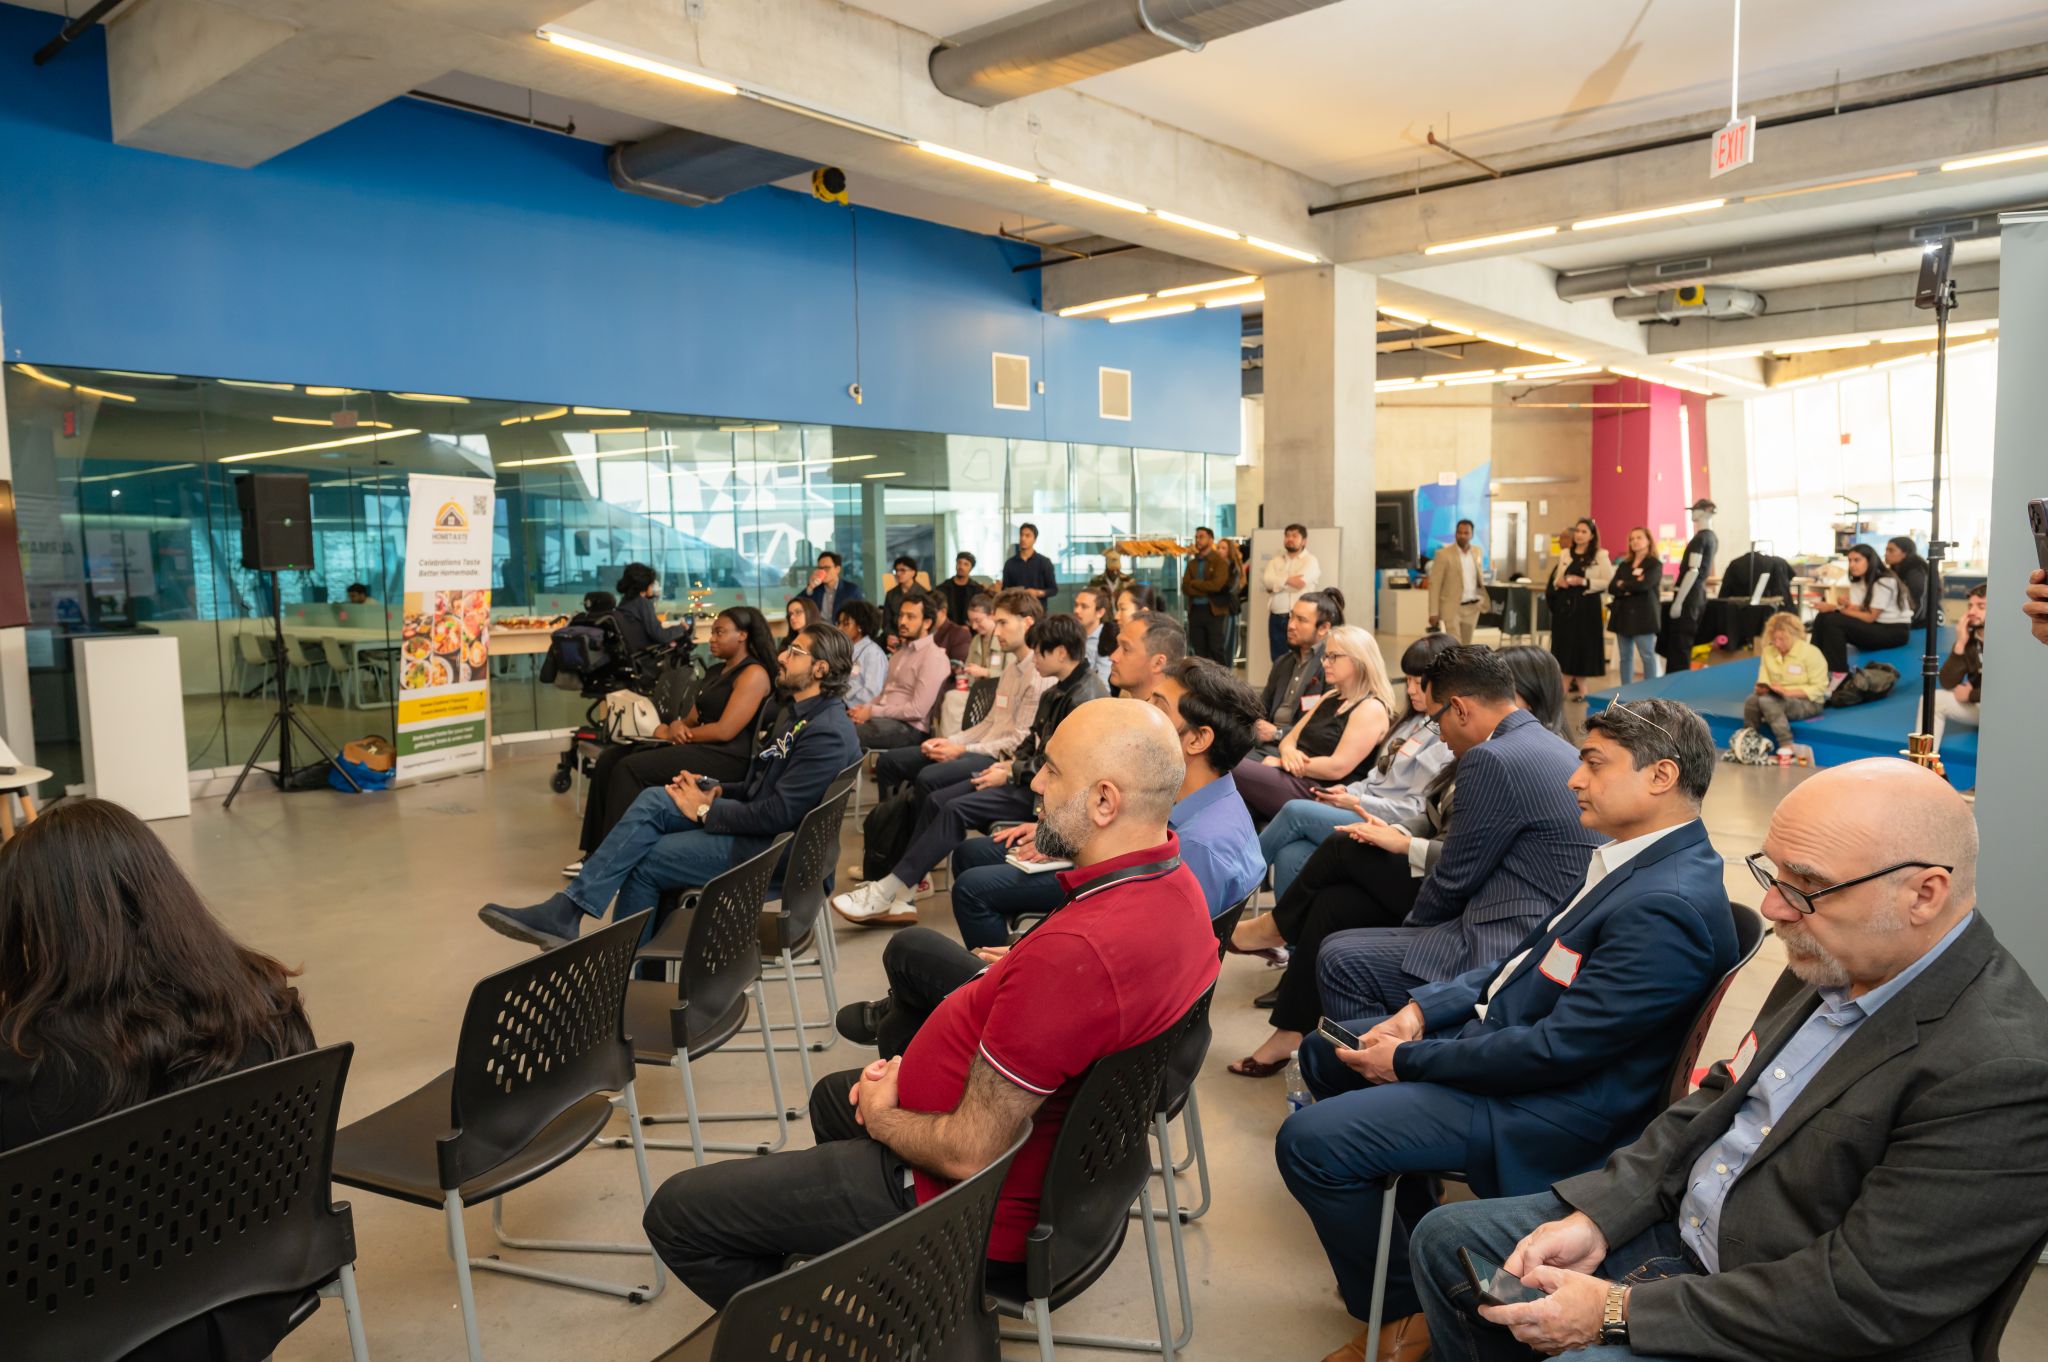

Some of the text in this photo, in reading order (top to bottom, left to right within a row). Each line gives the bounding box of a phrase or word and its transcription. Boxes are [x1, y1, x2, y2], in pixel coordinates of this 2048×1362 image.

[1717, 124, 1747, 169] EXIT
[418, 558, 481, 567] Celebrations Taste
[418, 569, 439, 577] Better
